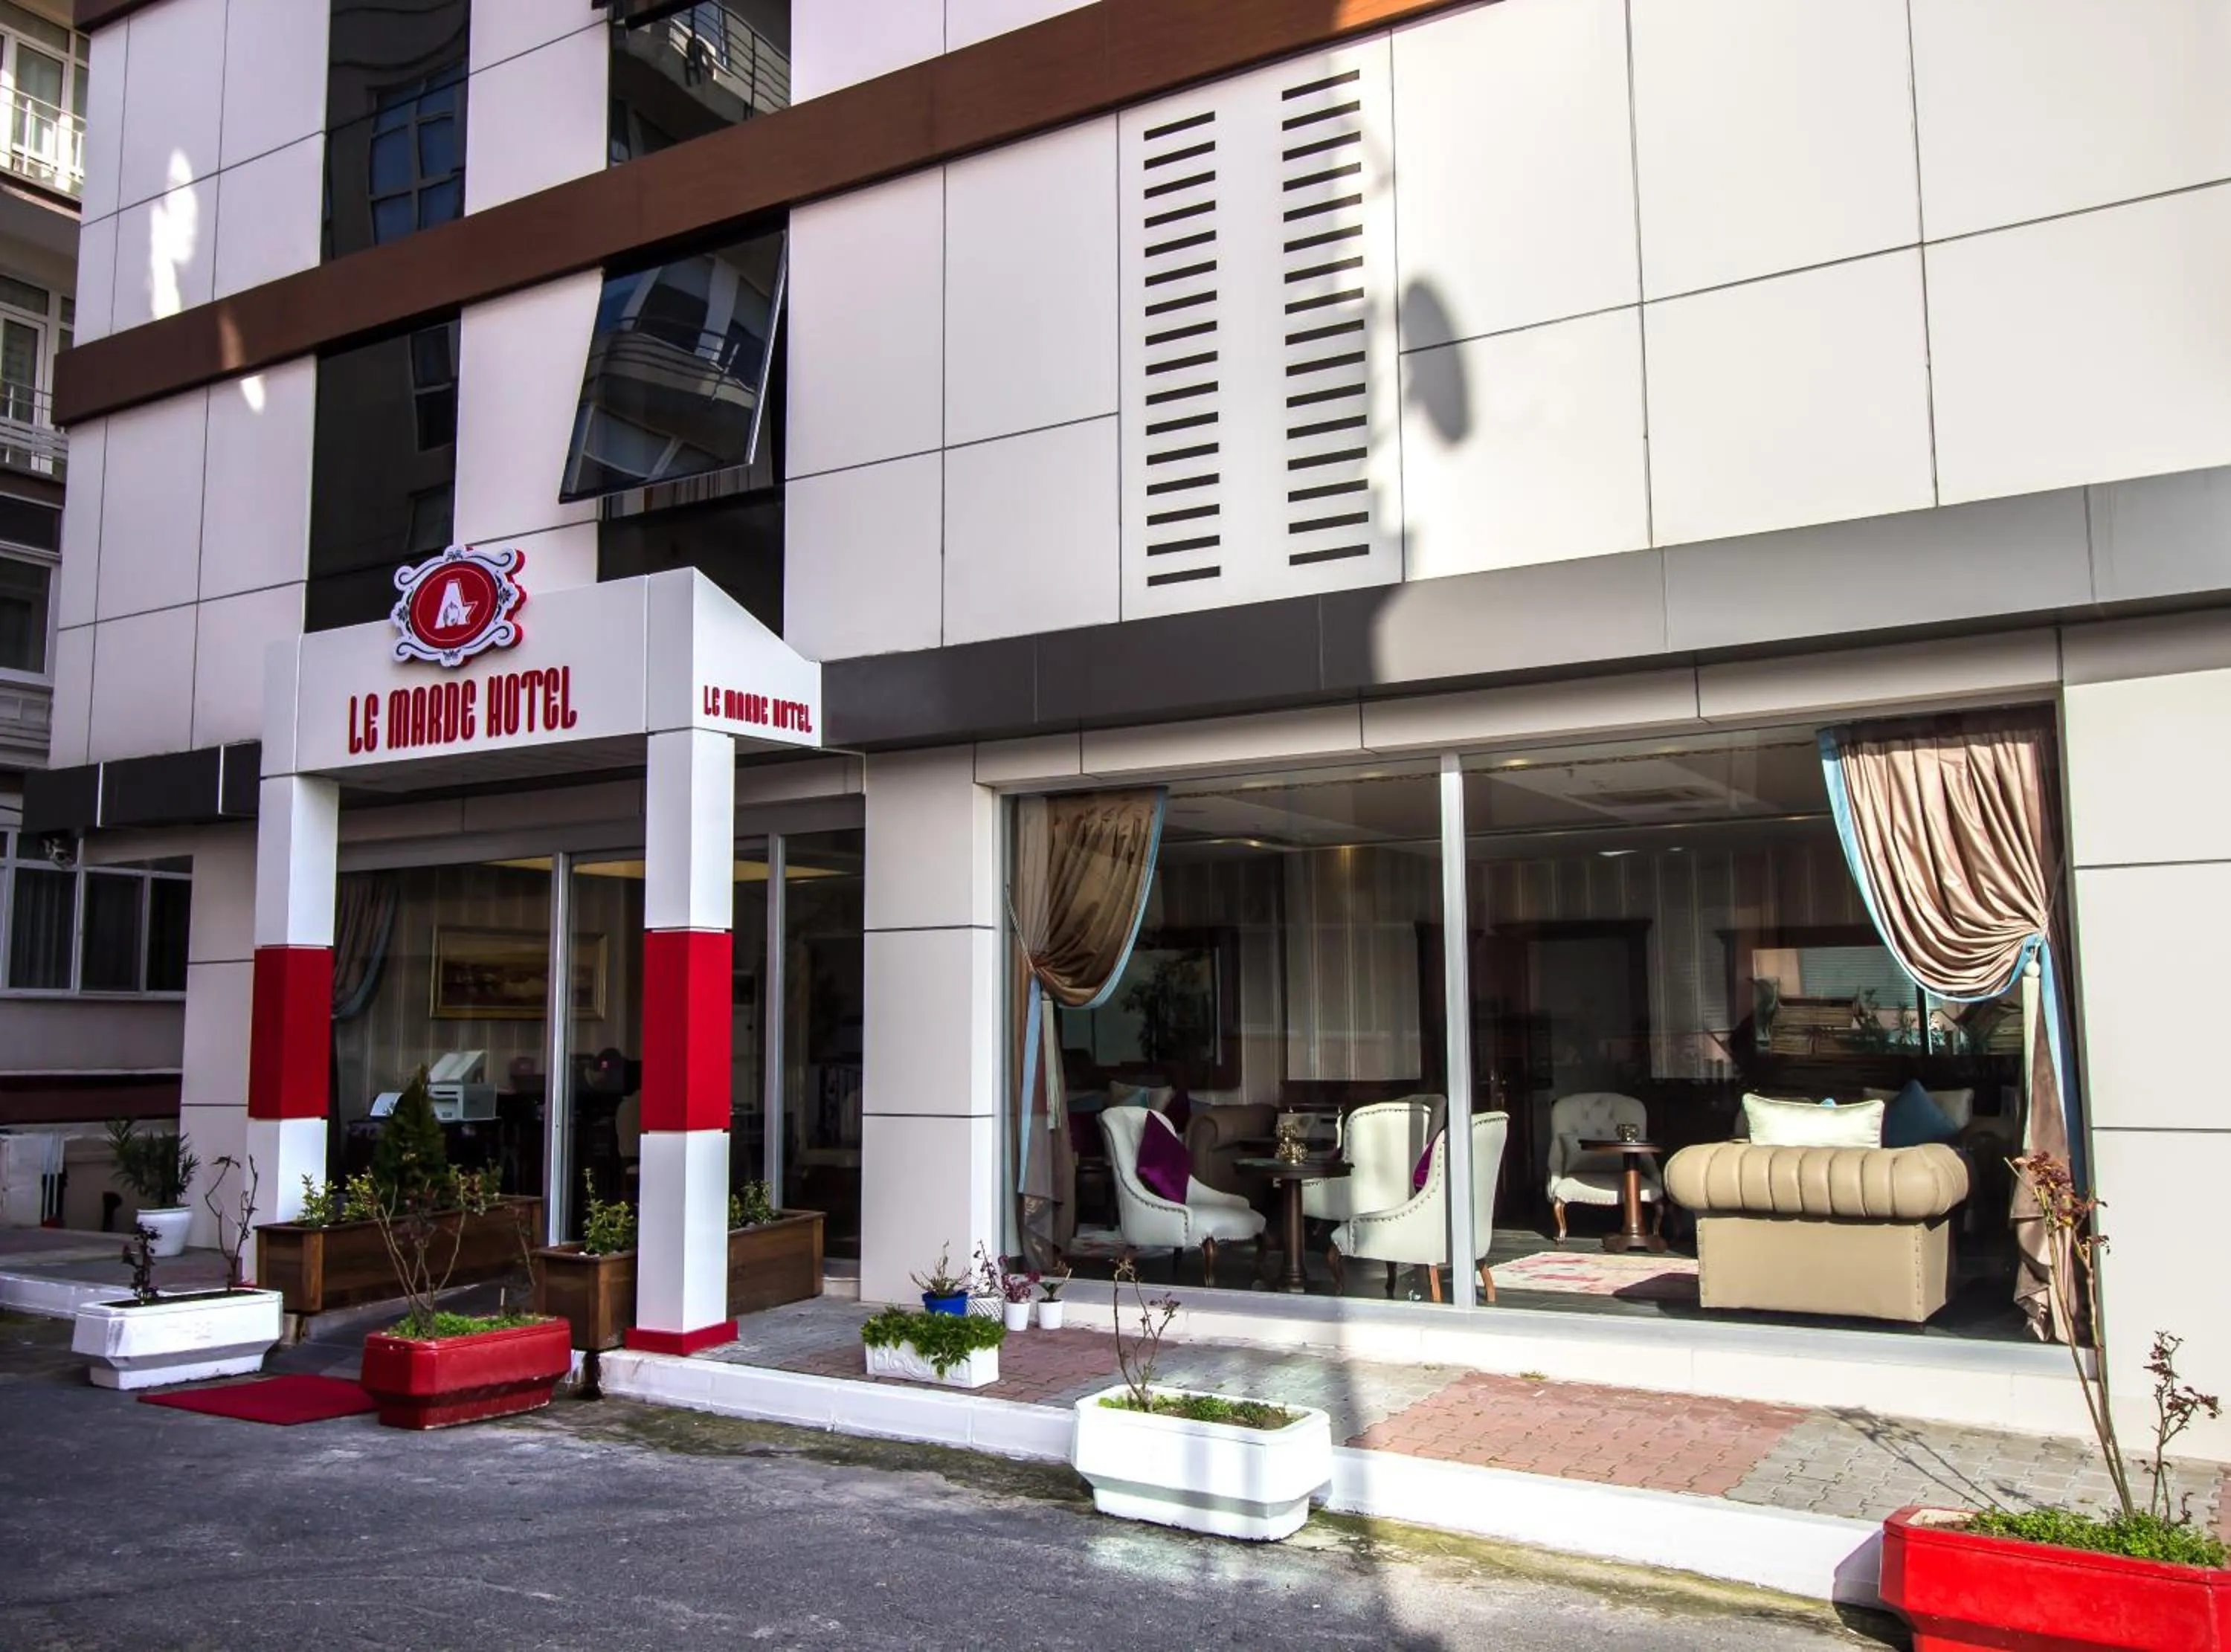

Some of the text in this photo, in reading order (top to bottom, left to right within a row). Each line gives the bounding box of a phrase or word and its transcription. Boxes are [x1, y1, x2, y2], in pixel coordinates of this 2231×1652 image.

[348, 665, 577, 754] LE MARDE HOTEL
[704, 685, 812, 733] LE MARDE HOTEL
